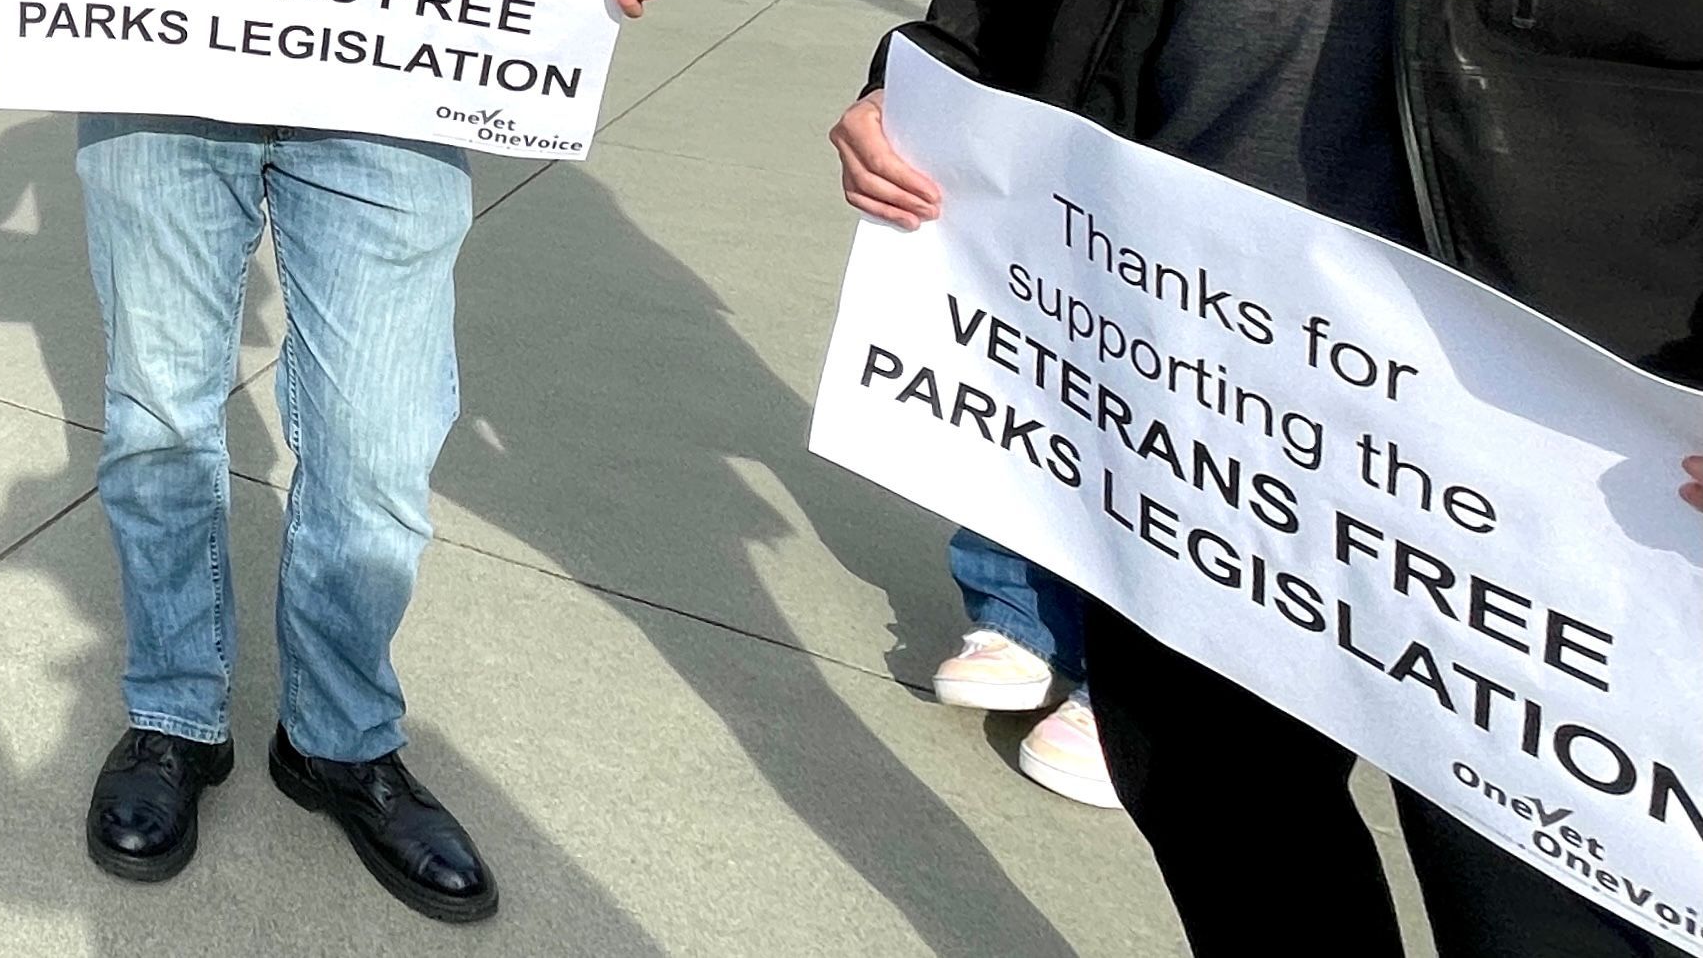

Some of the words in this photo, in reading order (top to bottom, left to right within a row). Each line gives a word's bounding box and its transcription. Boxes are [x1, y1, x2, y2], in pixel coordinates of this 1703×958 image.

[19, 2, 188, 44] PARKS
[209, 15, 582, 98] LEGISLATION
[436, 106, 516, 131] OneVet
[478, 128, 583, 151] OneVoice
[1053, 193, 1275, 347] Thanks
[1302, 316, 1419, 402] for
[1008, 263, 1324, 468] supporting
[1358, 434, 1498, 534] the
[947, 294, 1299, 536] VETERANS
[1336, 510, 1614, 693] FREE
[859, 343, 1082, 488] PARKS
[1103, 468, 1703, 843] LEGISLATION
[1452, 761, 1605, 861] OneVet
[1532, 830, 1703, 938] OneVoi
